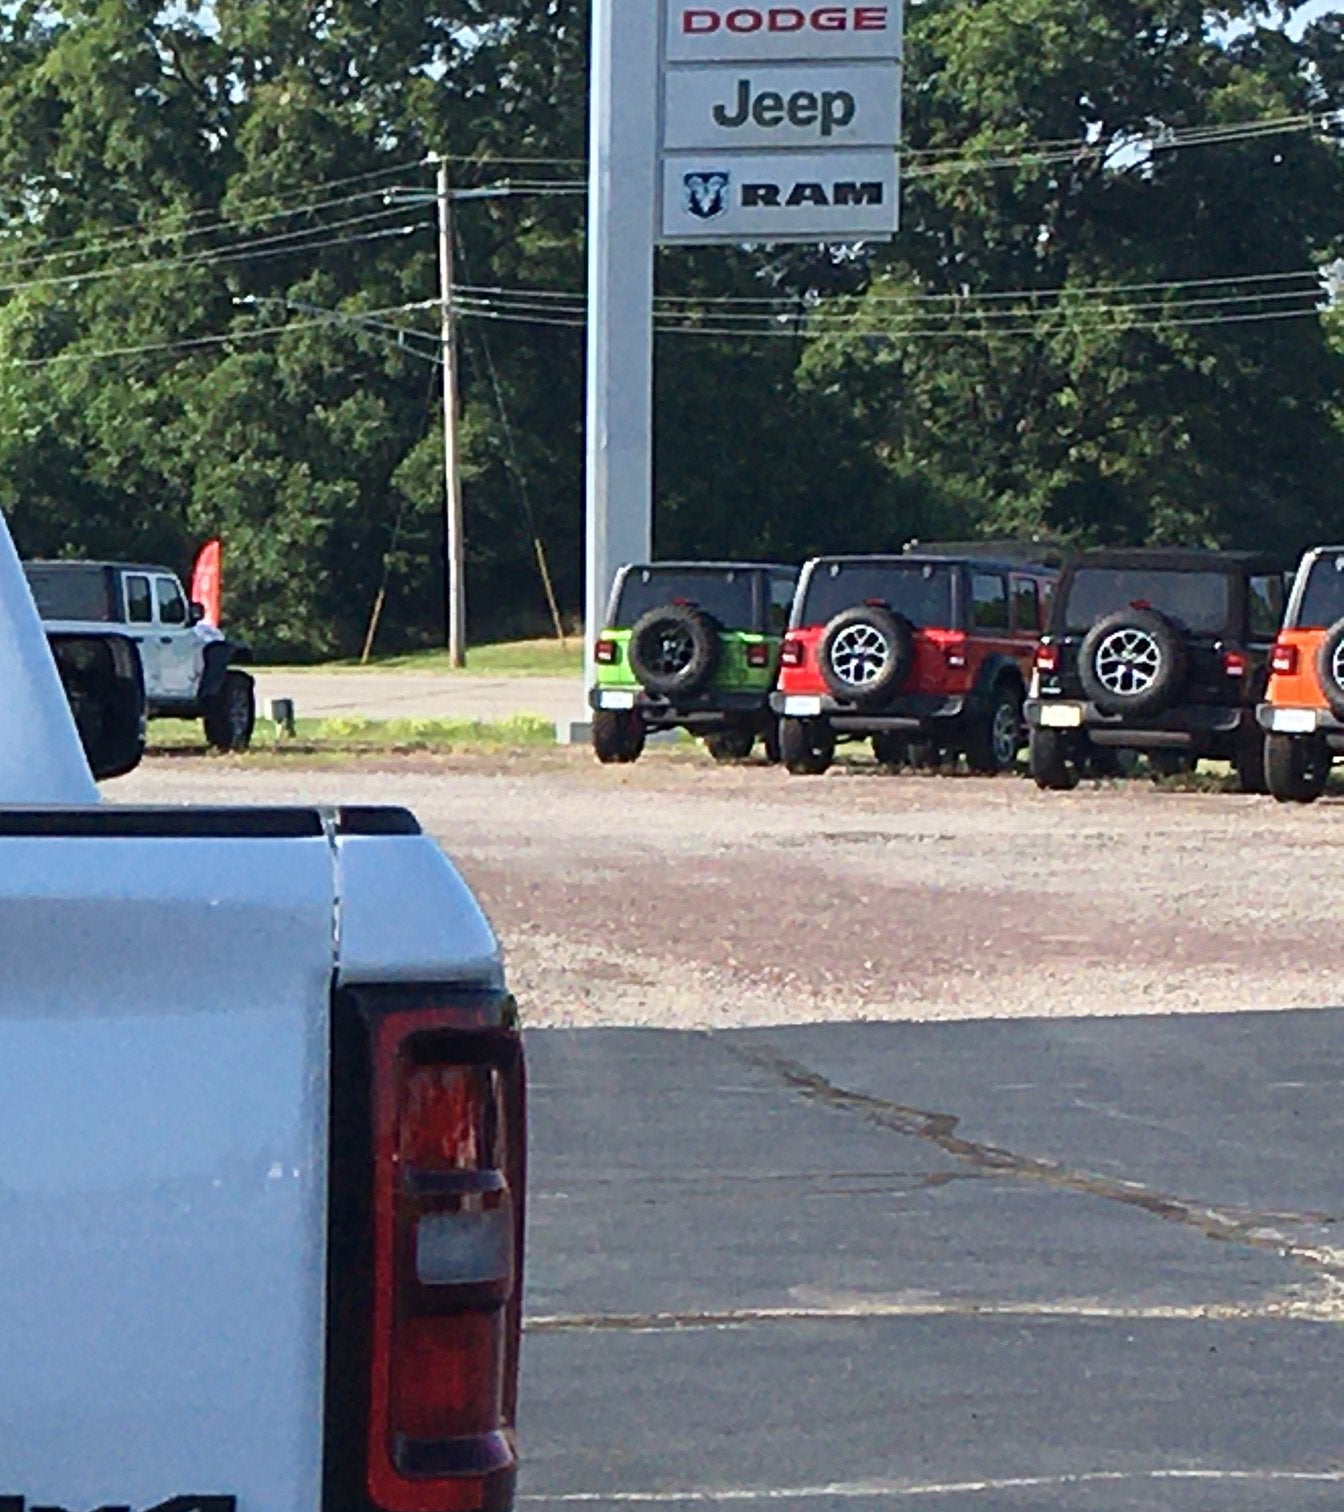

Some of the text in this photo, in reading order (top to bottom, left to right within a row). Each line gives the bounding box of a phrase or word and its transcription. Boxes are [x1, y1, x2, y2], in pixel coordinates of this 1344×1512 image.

[682, 7, 888, 34] DODGE
[713, 79, 856, 137] Jeep
[741, 182, 884, 207] RAM
